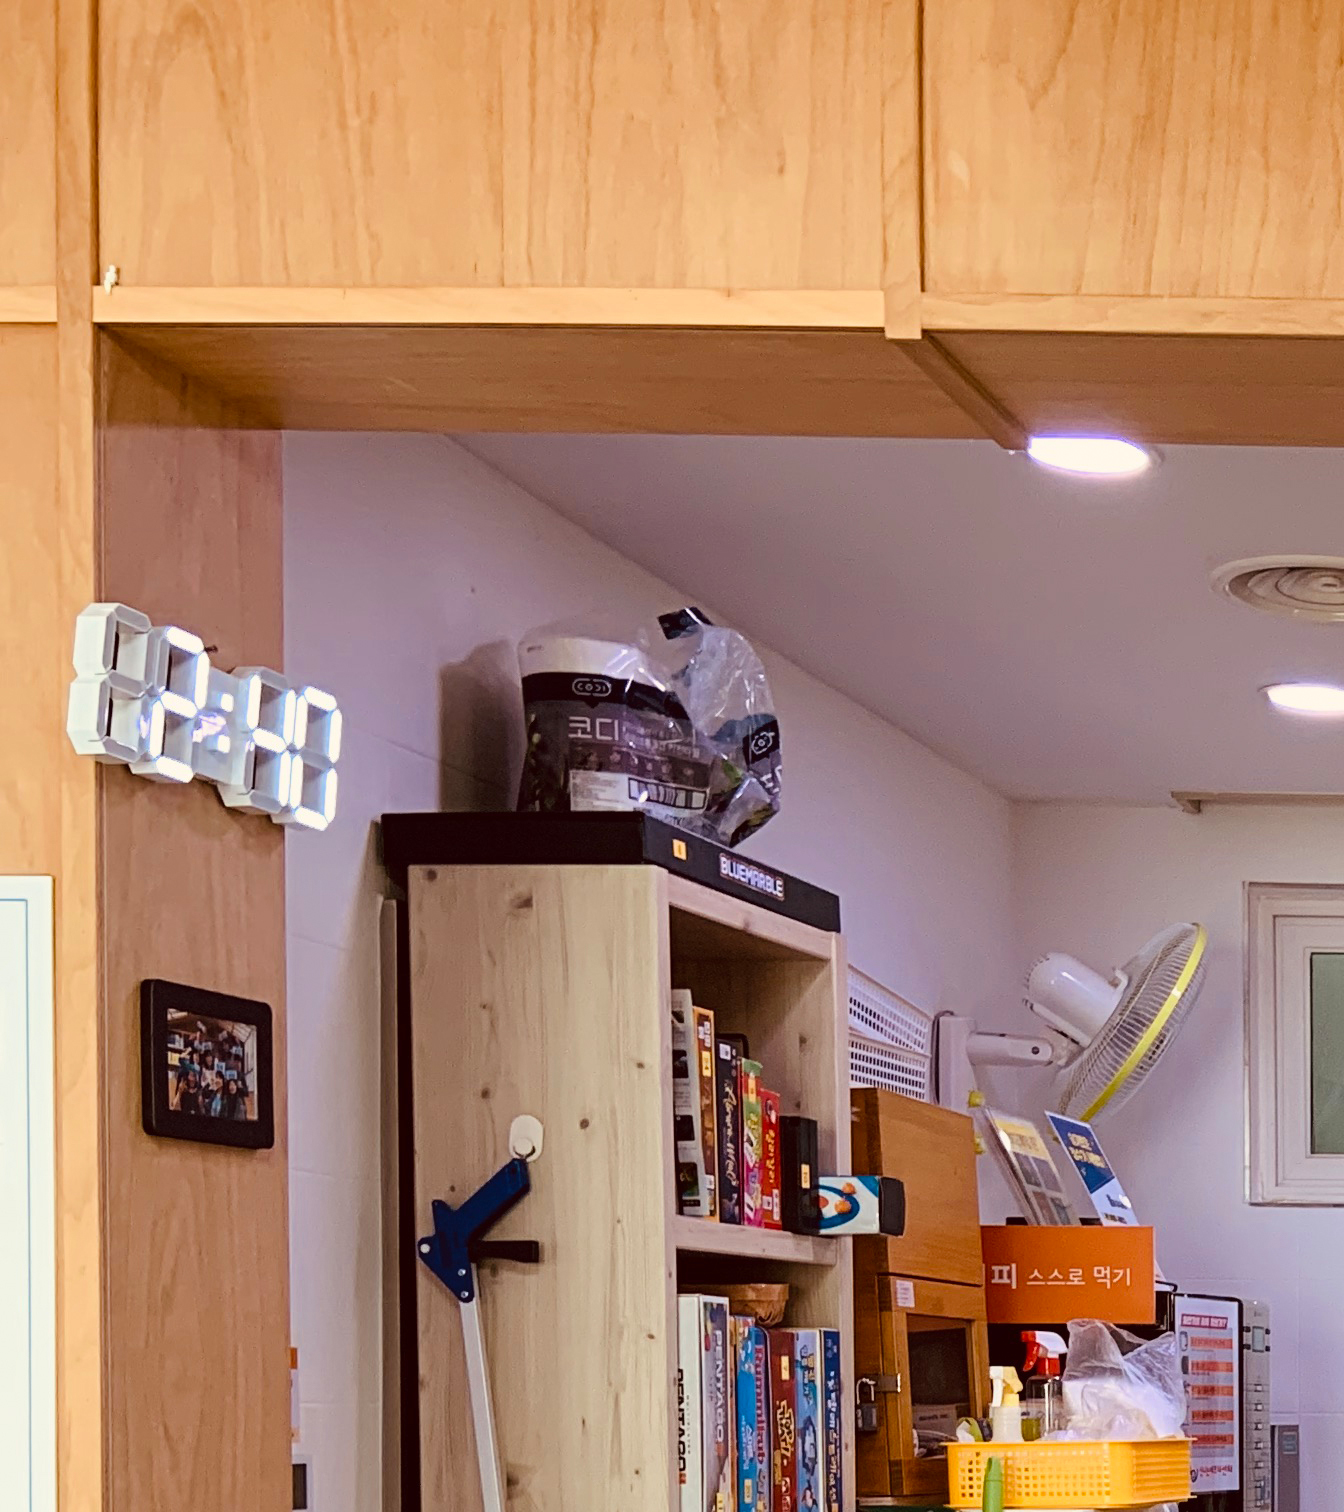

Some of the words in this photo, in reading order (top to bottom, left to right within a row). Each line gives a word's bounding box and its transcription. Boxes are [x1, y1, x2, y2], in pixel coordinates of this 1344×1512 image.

[568, 715, 619, 741] 코디
[720, 853, 784, 898] BLUEMARBLE
[1026, 1268, 1086, 1286] 스스로
[1093, 1265, 1131, 1290] 먹기
[714, 1329, 725, 1442] PENTAGO
[755, 1344, 766, 1465] Rummikub
